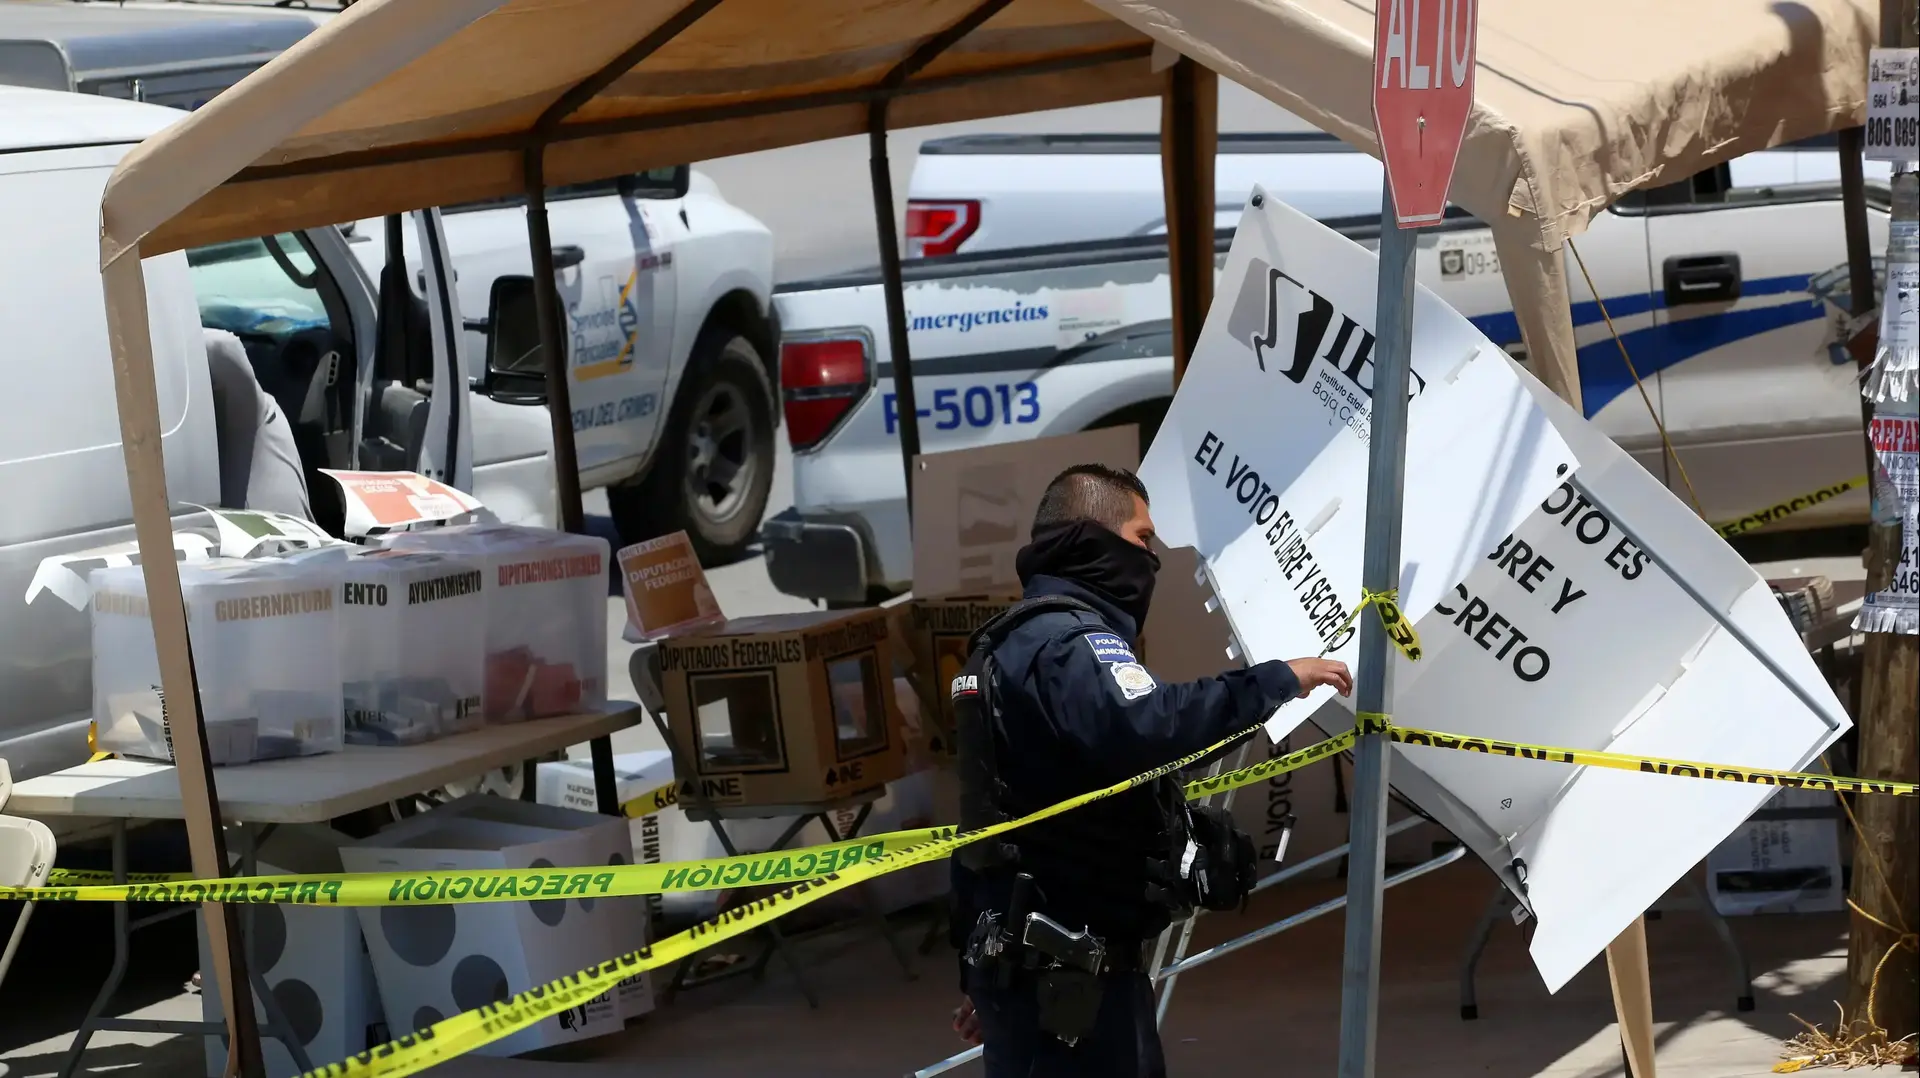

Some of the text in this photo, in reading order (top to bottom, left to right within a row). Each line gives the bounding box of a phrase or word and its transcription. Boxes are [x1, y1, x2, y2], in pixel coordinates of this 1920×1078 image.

[1381, 0, 1471, 90] ALTO
[1867, 116, 1892, 148] 806
[904, 299, 1049, 333] Emergencias
[1311, 380, 1339, 414] Baja
[1318, 368, 1347, 399] Instituto
[1193, 431, 1356, 654] EL VOTO ES LIBRE Y SECRETO
[1604, 535, 1653, 581] ES
[344, 569, 482, 606] ENTO AYUNTAMIENTO
[498, 558, 564, 587] DIPUTACIONES
[214, 587, 333, 622] GUBERNATURA
[1551, 576, 1588, 615] Y
[658, 638, 802, 672] DIPUTADOS FEDERALES
[702, 776, 743, 798] INE
[840, 762, 863, 783] INE
